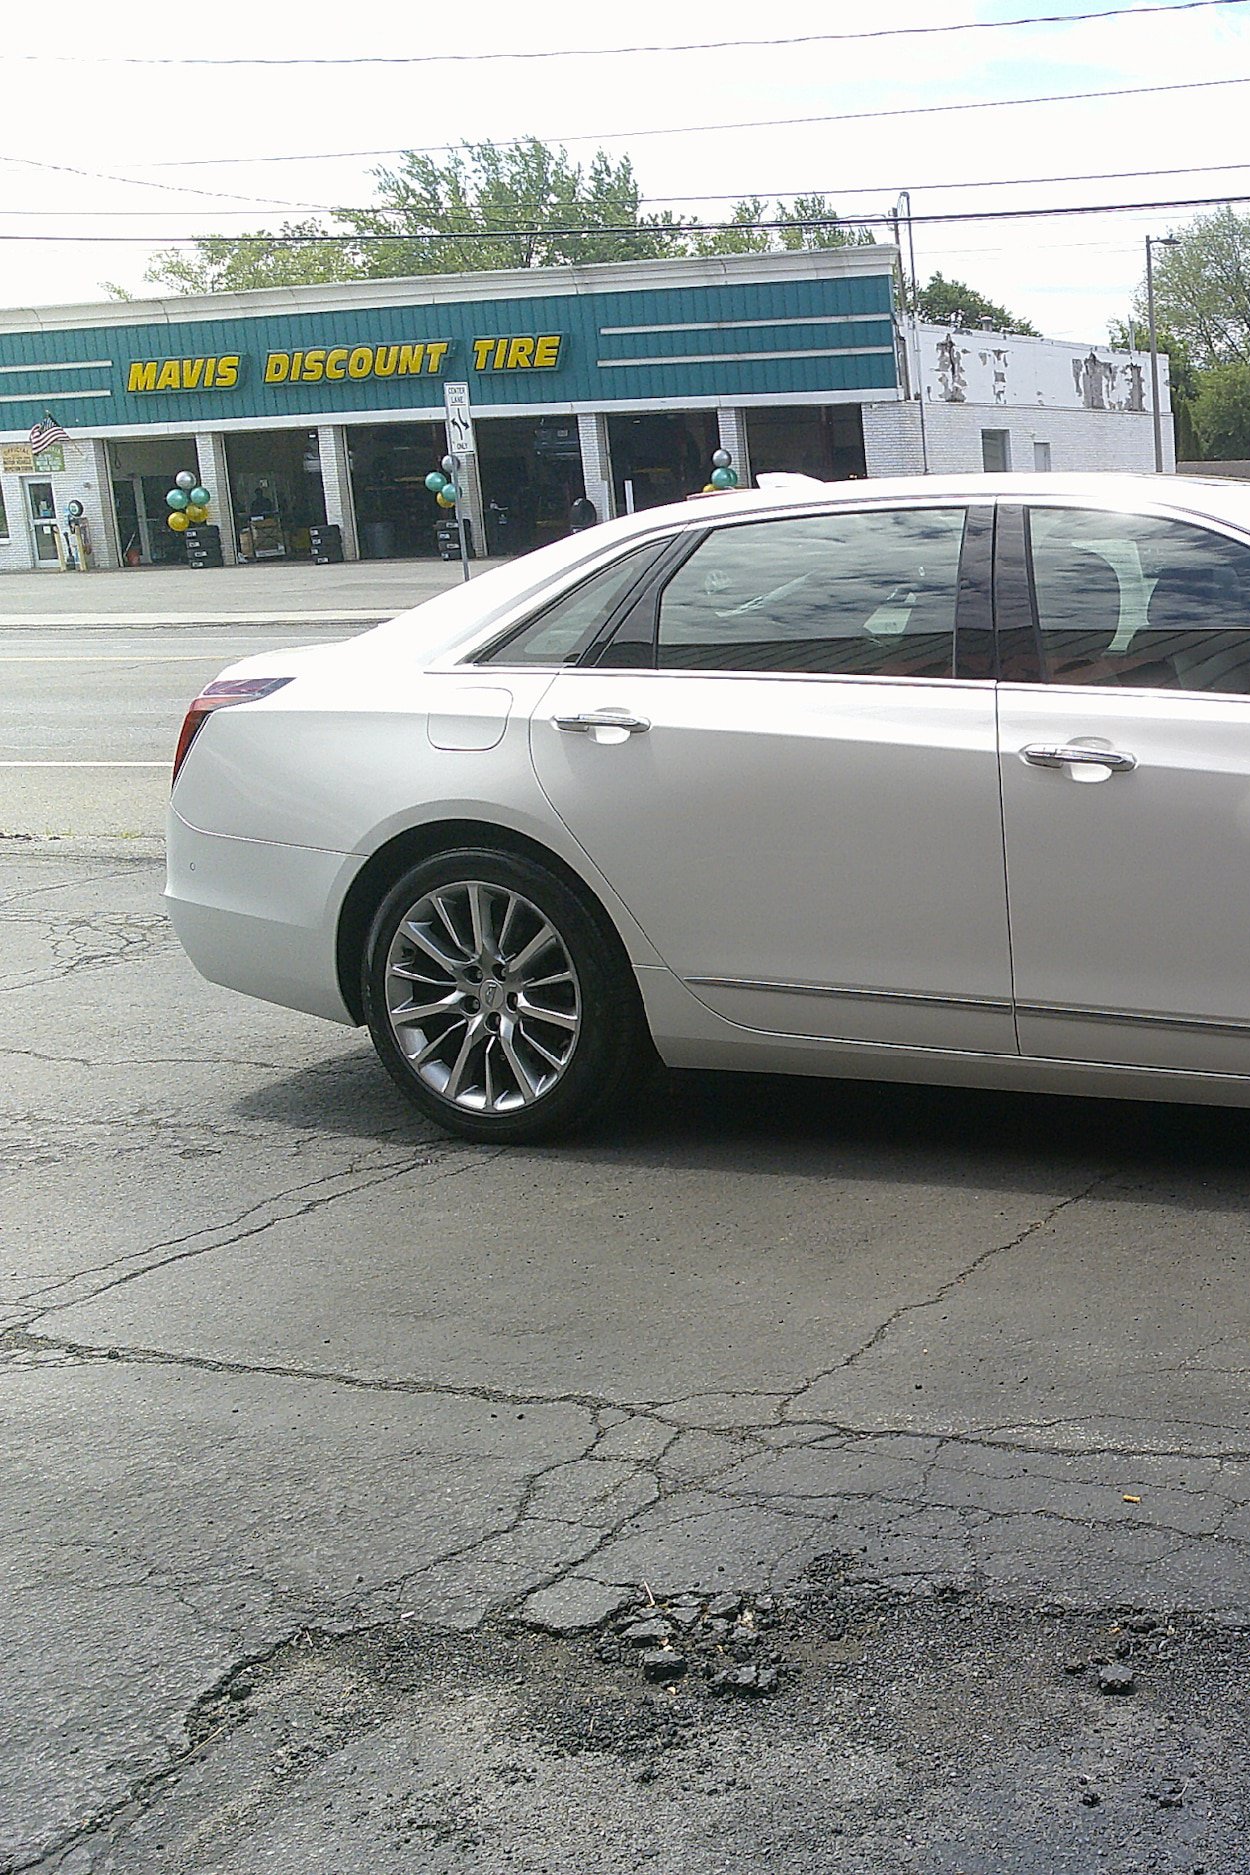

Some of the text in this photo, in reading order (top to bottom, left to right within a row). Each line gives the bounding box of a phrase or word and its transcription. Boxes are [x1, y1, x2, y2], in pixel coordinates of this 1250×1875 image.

[127, 336, 562, 392] MAVIS DISCOUNT TIRE
[448, 386, 465, 394] CENTER
[451, 396, 463, 404] LANE
